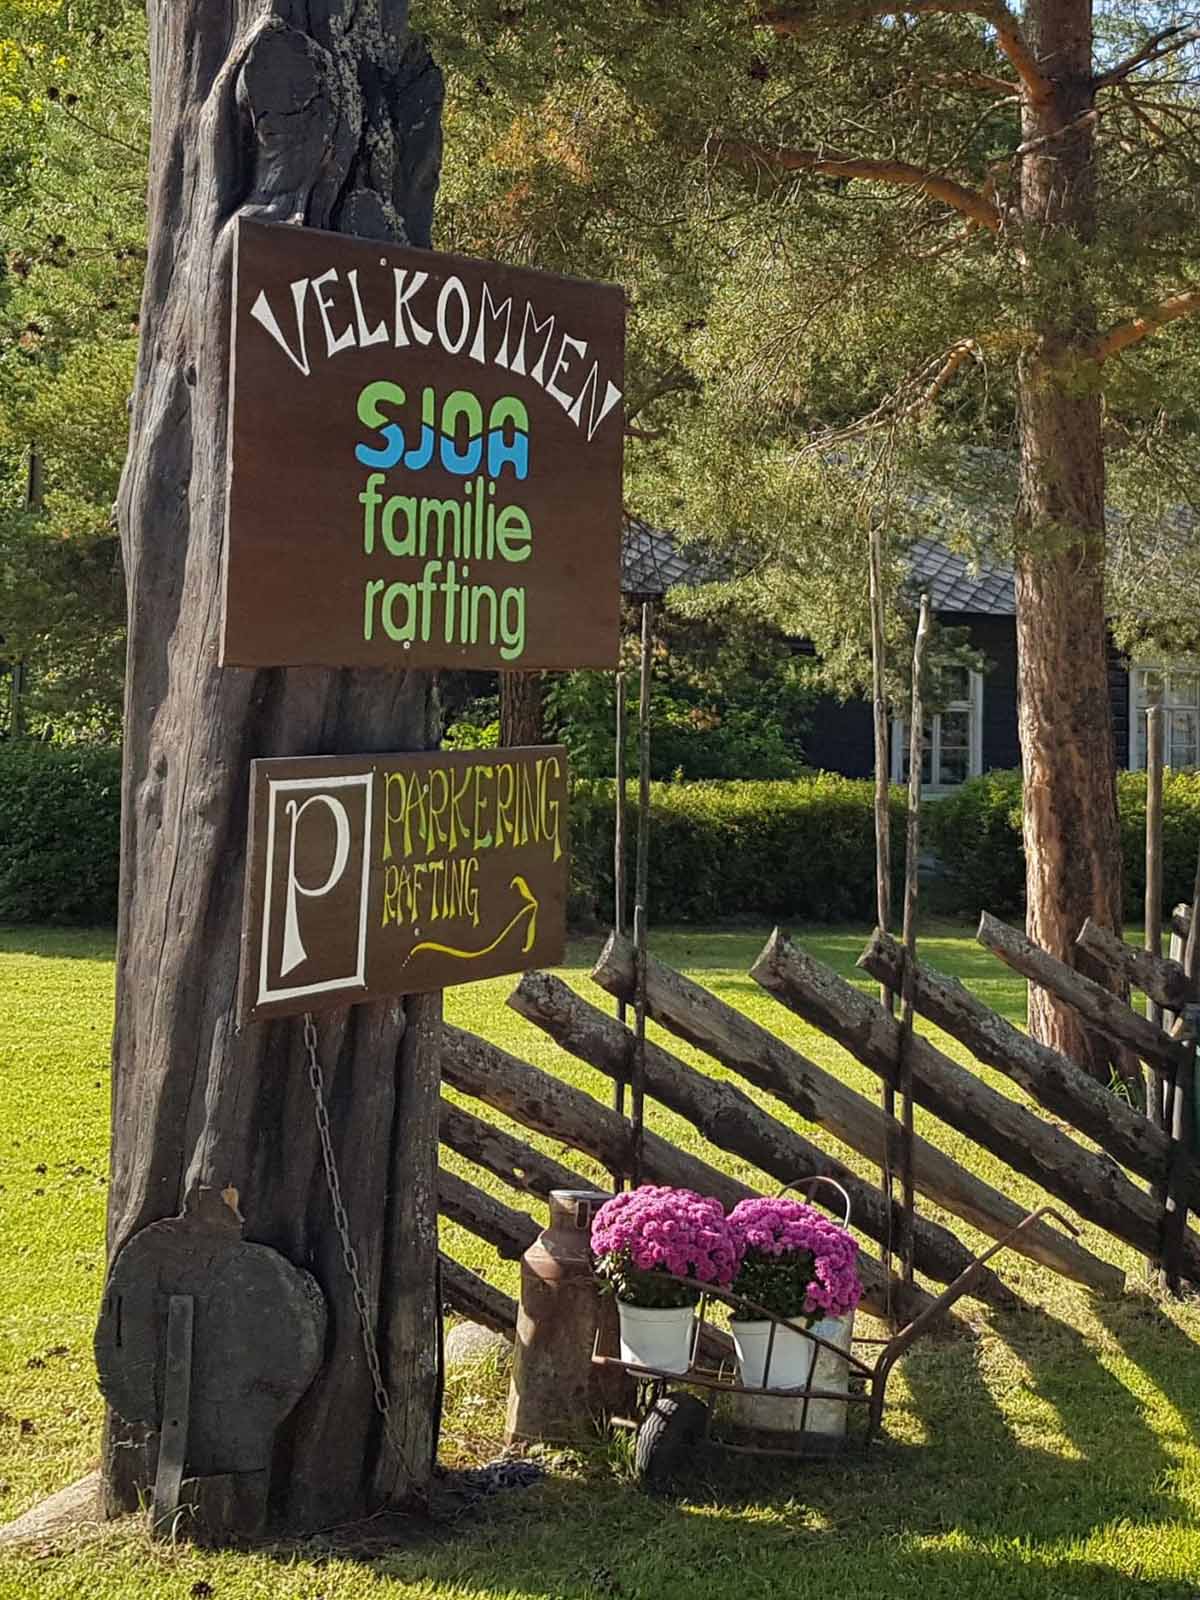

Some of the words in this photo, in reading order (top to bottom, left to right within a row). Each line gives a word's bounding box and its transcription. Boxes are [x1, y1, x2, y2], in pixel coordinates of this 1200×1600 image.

[250, 267, 623, 442] VELKOMMEN
[355, 381, 529, 480] SJOA
[359, 473, 533, 562] familie
[363, 561, 526, 660] rafting
[382, 757, 562, 862] PARKERING
[279, 794, 350, 978] P
[382, 857, 480, 928] RAFTING
